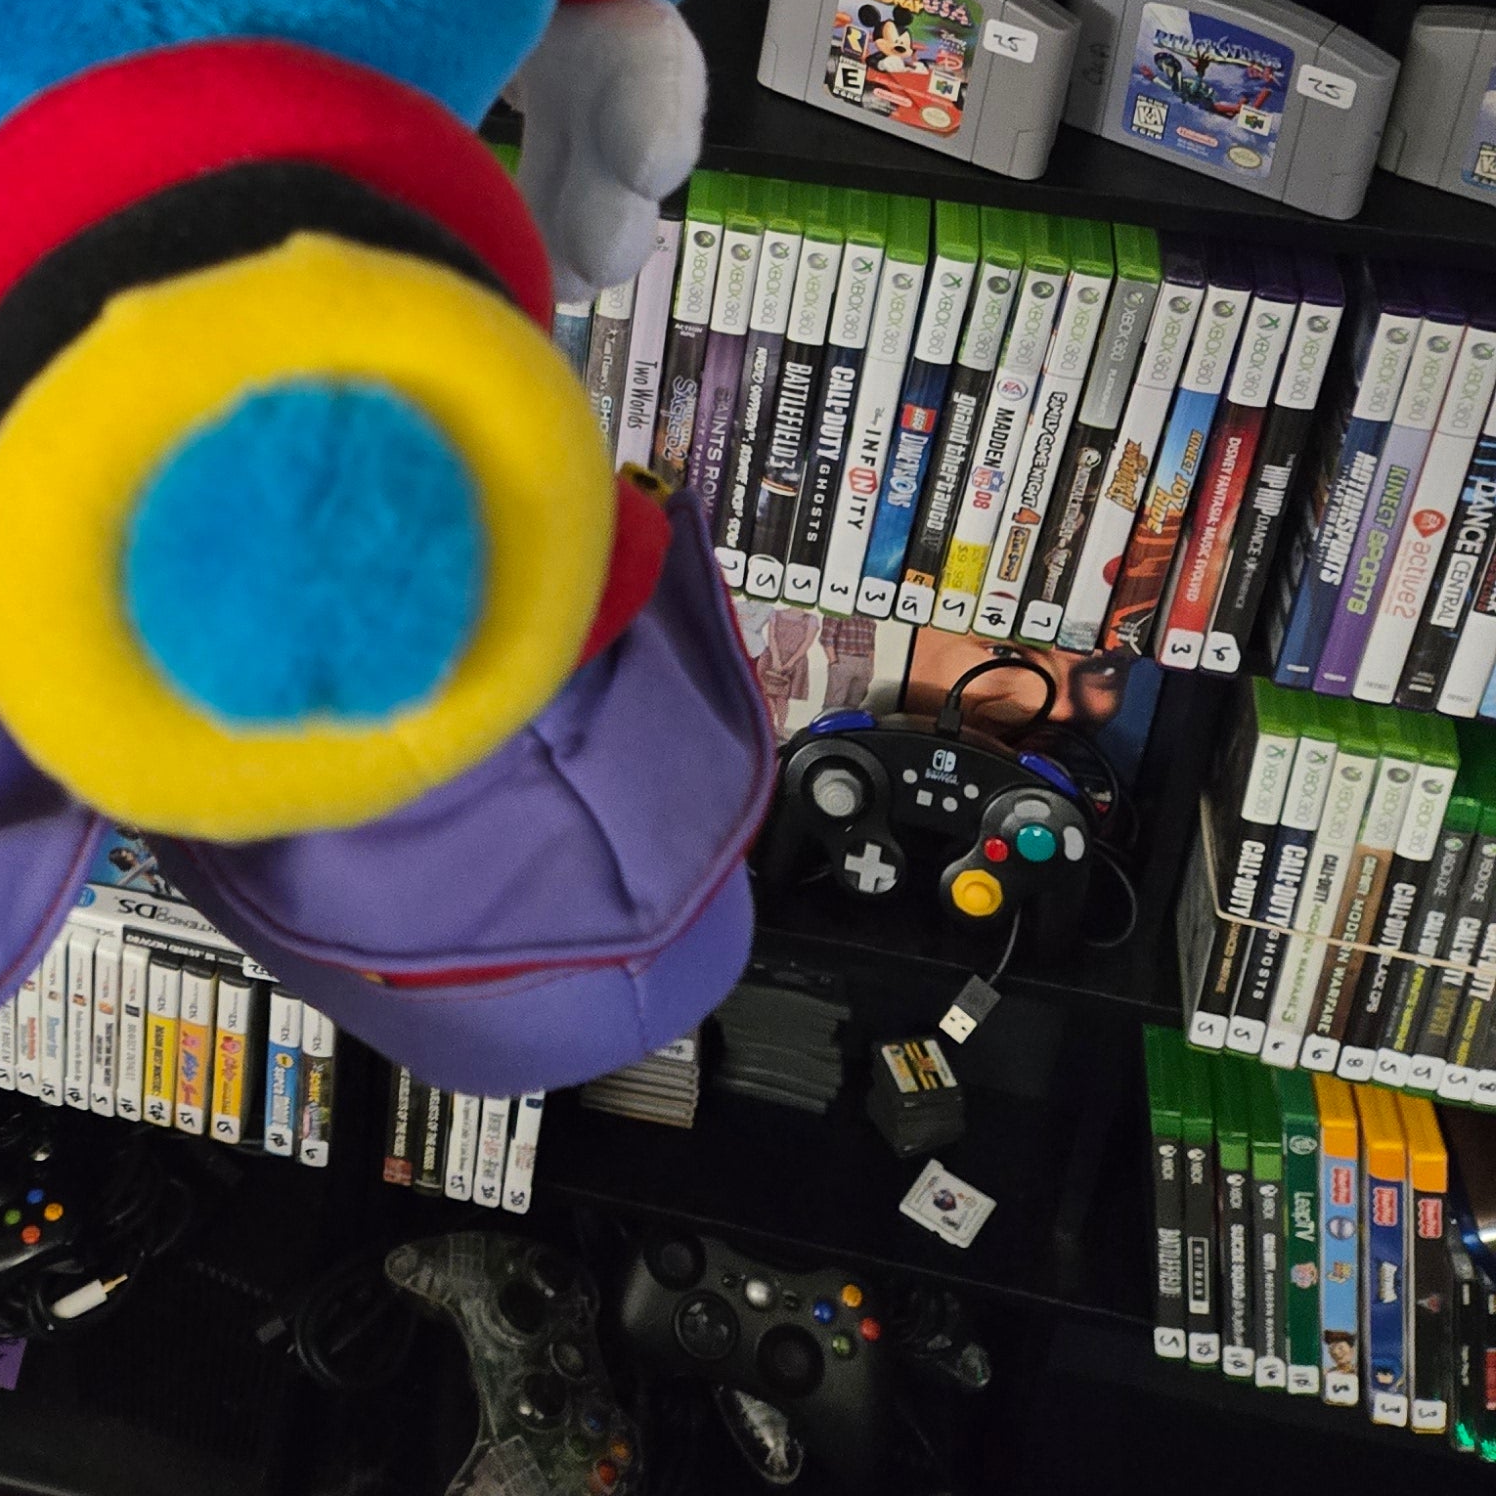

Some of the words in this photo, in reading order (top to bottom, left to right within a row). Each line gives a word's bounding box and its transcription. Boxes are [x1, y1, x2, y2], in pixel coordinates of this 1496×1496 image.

[993, 33, 1026, 52] 25
[842, 67, 860, 89] E
[1308, 77, 1344, 100] 25
[635, 360, 658, 387] Two
[824, 366, 855, 410] CALL
[627, 387, 650, 430] Worlds
[772, 361, 812, 460] BATTLEFIELD
[816, 412, 846, 461] DUTY
[984, 407, 1016, 469] MADDEN
[806, 464, 831, 542] GHOSTS
[847, 428, 882, 531] INFINITY
[973, 492, 992, 510] 08
[1373, 464, 1409, 530] KINECT
[1455, 480, 1496, 555] DANCE
[1346, 532, 1390, 616] SPORTS
[1435, 559, 1472, 623] CENTRAL
